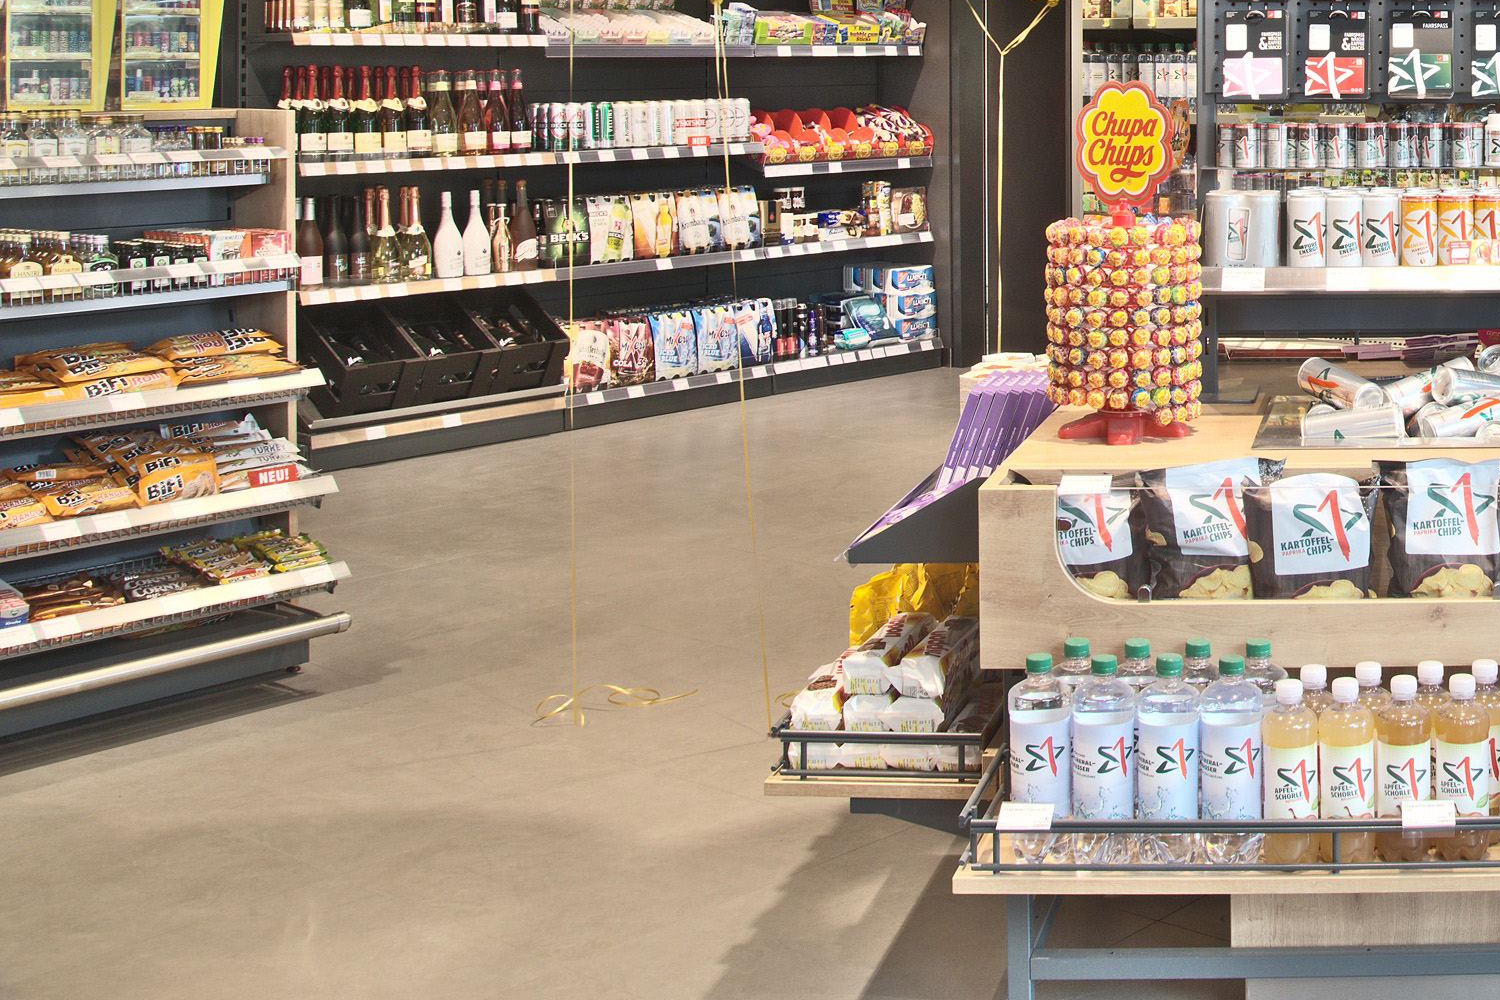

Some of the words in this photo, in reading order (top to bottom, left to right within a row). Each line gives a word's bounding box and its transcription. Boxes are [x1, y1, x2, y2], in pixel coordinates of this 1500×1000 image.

[1091, 110, 1159, 145] Chupa
[1087, 137, 1155, 174] Chups
[681, 219, 708, 228] Krombache
[1304, 241, 1318, 249] PURE
[1343, 241, 1357, 249] PURE
[1375, 241, 1390, 249] PURE
[1299, 246, 1320, 257] ENERGY
[1371, 246, 1392, 257] ENERGY
[907, 271, 927, 282] weich
[912, 295, 932, 307] weich
[910, 320, 932, 332] weich
[612, 358, 633, 367] COLA
[131, 371, 161, 388] Roll
[171, 422, 204, 439] BiFi
[251, 443, 287, 456] TURKEY
[144, 455, 182, 474] BiFi
[258, 468, 290, 485] NEU!
[146, 473, 184, 501] BiFi
[1059, 526, 1096, 540] RTOFFEL-
[169, 542, 188, 551] PICK
[188, 547, 208, 557] PICK
[204, 556, 224, 566] PICK
[1330, 783, 1352, 793] APFEL-
[1384, 781, 1406, 793] APFEL-
[1440, 780, 1461, 790] APFEL-
[1275, 790, 1304, 801] SCHORLE
[1384, 788, 1411, 798] SCHORLE
[1441, 786, 1467, 796] SCHORLE
